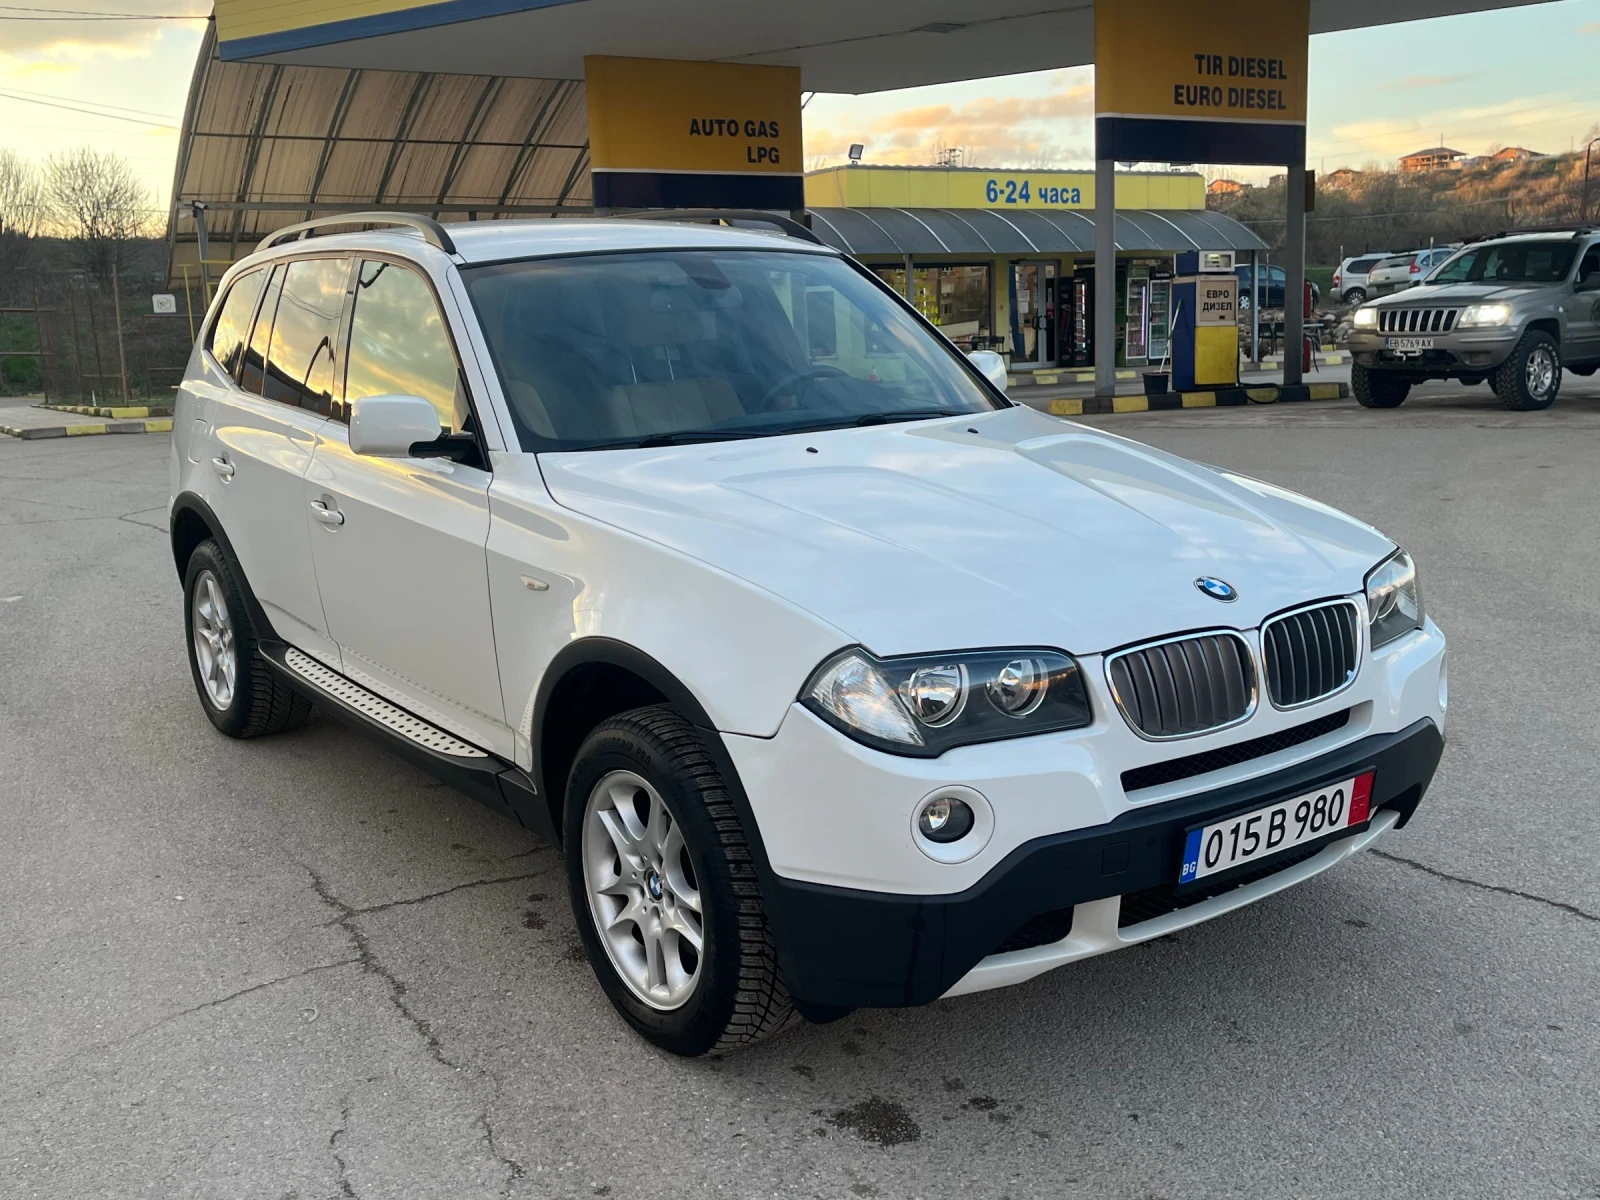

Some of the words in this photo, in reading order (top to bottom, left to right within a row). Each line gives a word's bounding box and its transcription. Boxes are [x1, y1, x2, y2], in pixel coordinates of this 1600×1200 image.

[1194, 54, 1223, 76] TIR
[1228, 56, 1287, 80] DIESEL
[1174, 84, 1223, 107] EURO
[1227, 87, 1287, 110] DIESEL
[689, 118, 739, 137] AUTO
[744, 120, 779, 138] GAS
[746, 146, 780, 164] LPG
[986, 179, 1031, 204] 6-24
[1038, 187, 1081, 204] часа
[1206, 289, 1230, 299] ЕВРО
[1202, 301, 1232, 313] ДИЗЕЛ
[635, 746, 652, 765] PRO
[1181, 861, 1197, 876] BG
